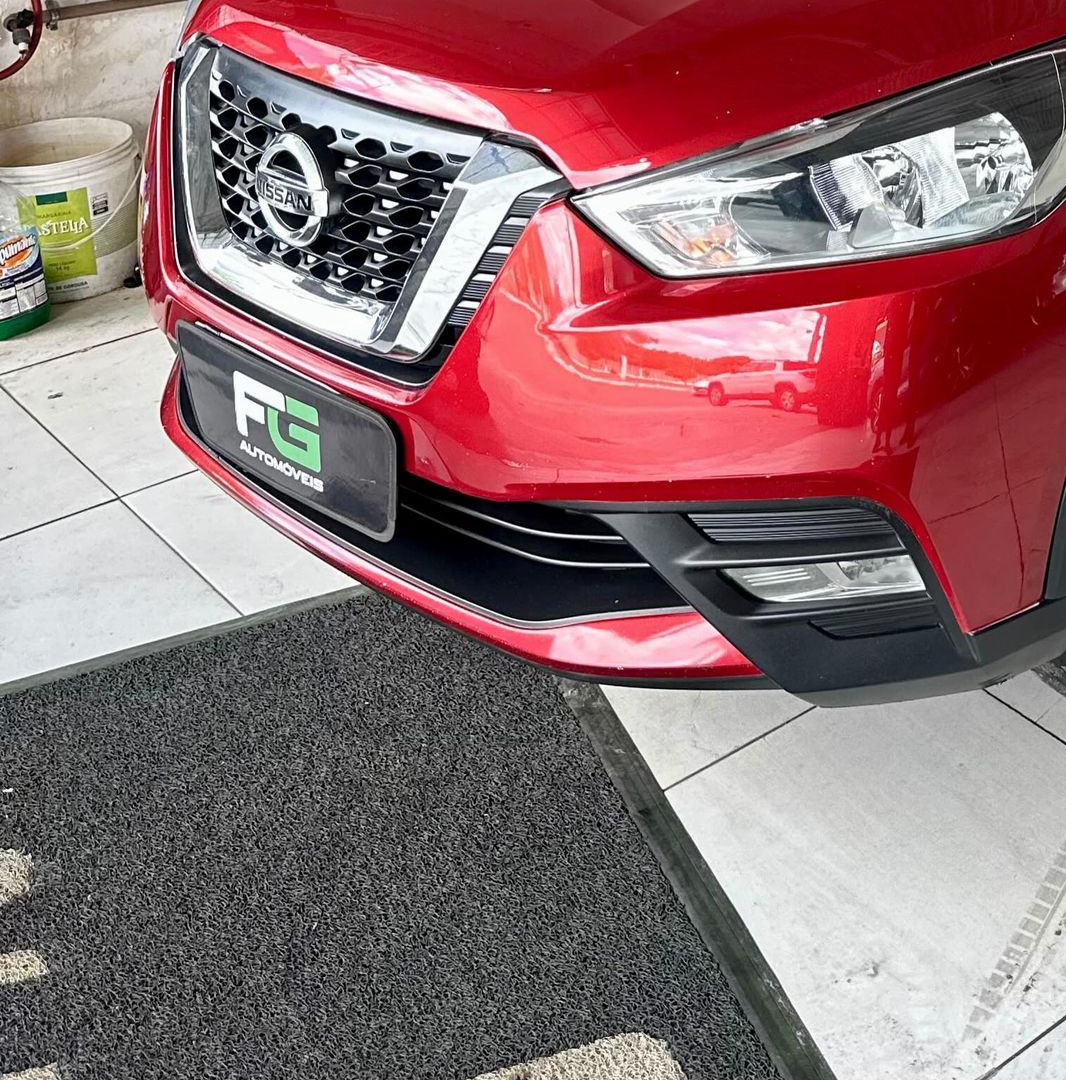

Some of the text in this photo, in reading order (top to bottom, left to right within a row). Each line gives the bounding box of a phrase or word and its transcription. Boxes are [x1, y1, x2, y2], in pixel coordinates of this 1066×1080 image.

[257, 179, 313, 212] NISSAN
[233, 370, 321, 473] FG
[240, 439, 324, 493] AUTOMÓVEIS
